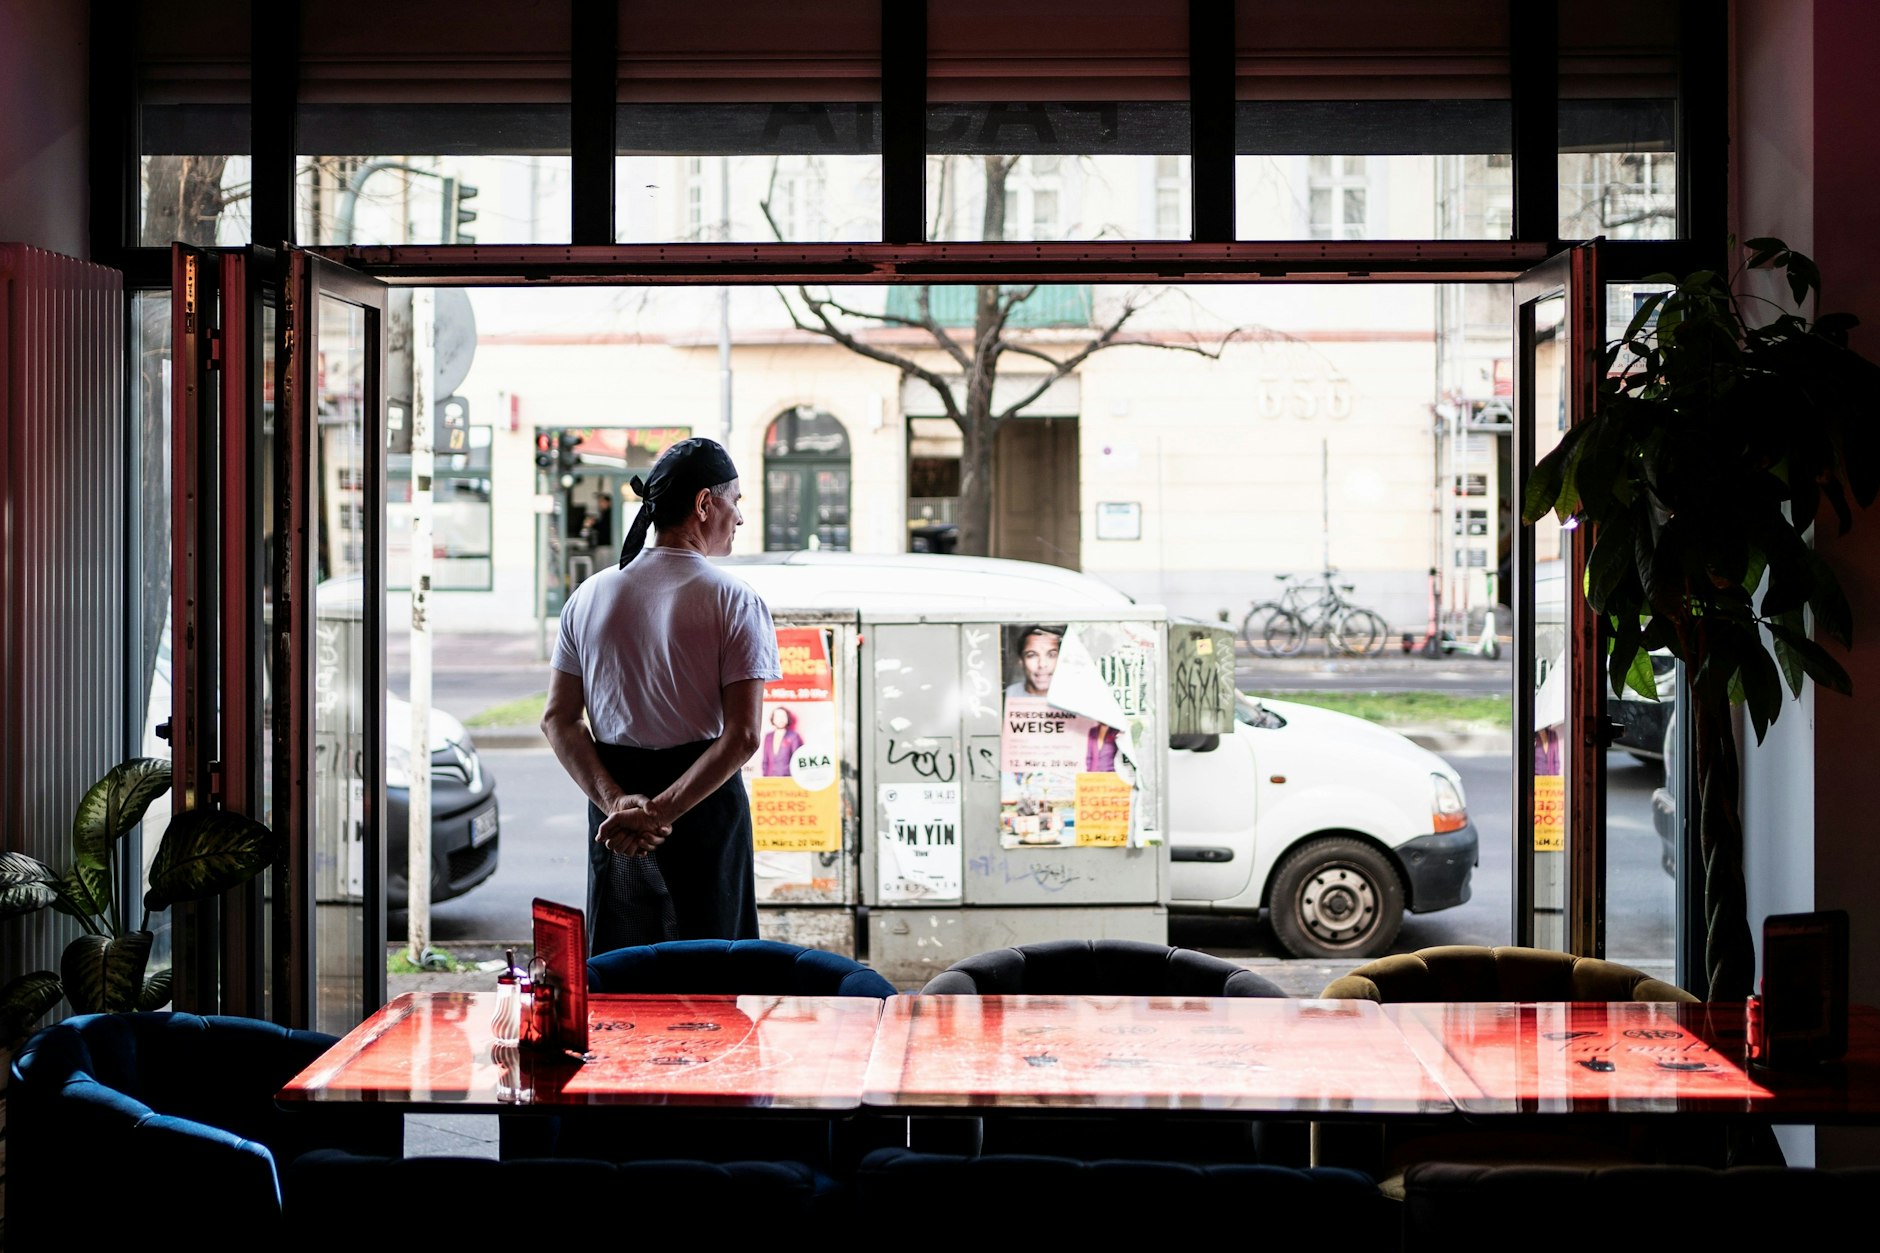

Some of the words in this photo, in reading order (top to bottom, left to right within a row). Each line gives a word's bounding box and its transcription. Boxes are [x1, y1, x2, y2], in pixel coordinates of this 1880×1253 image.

[1009, 711, 1077, 719] FRIEDEMANN
[1010, 721, 1065, 734] WEISE
[798, 755, 831, 769] BKA
